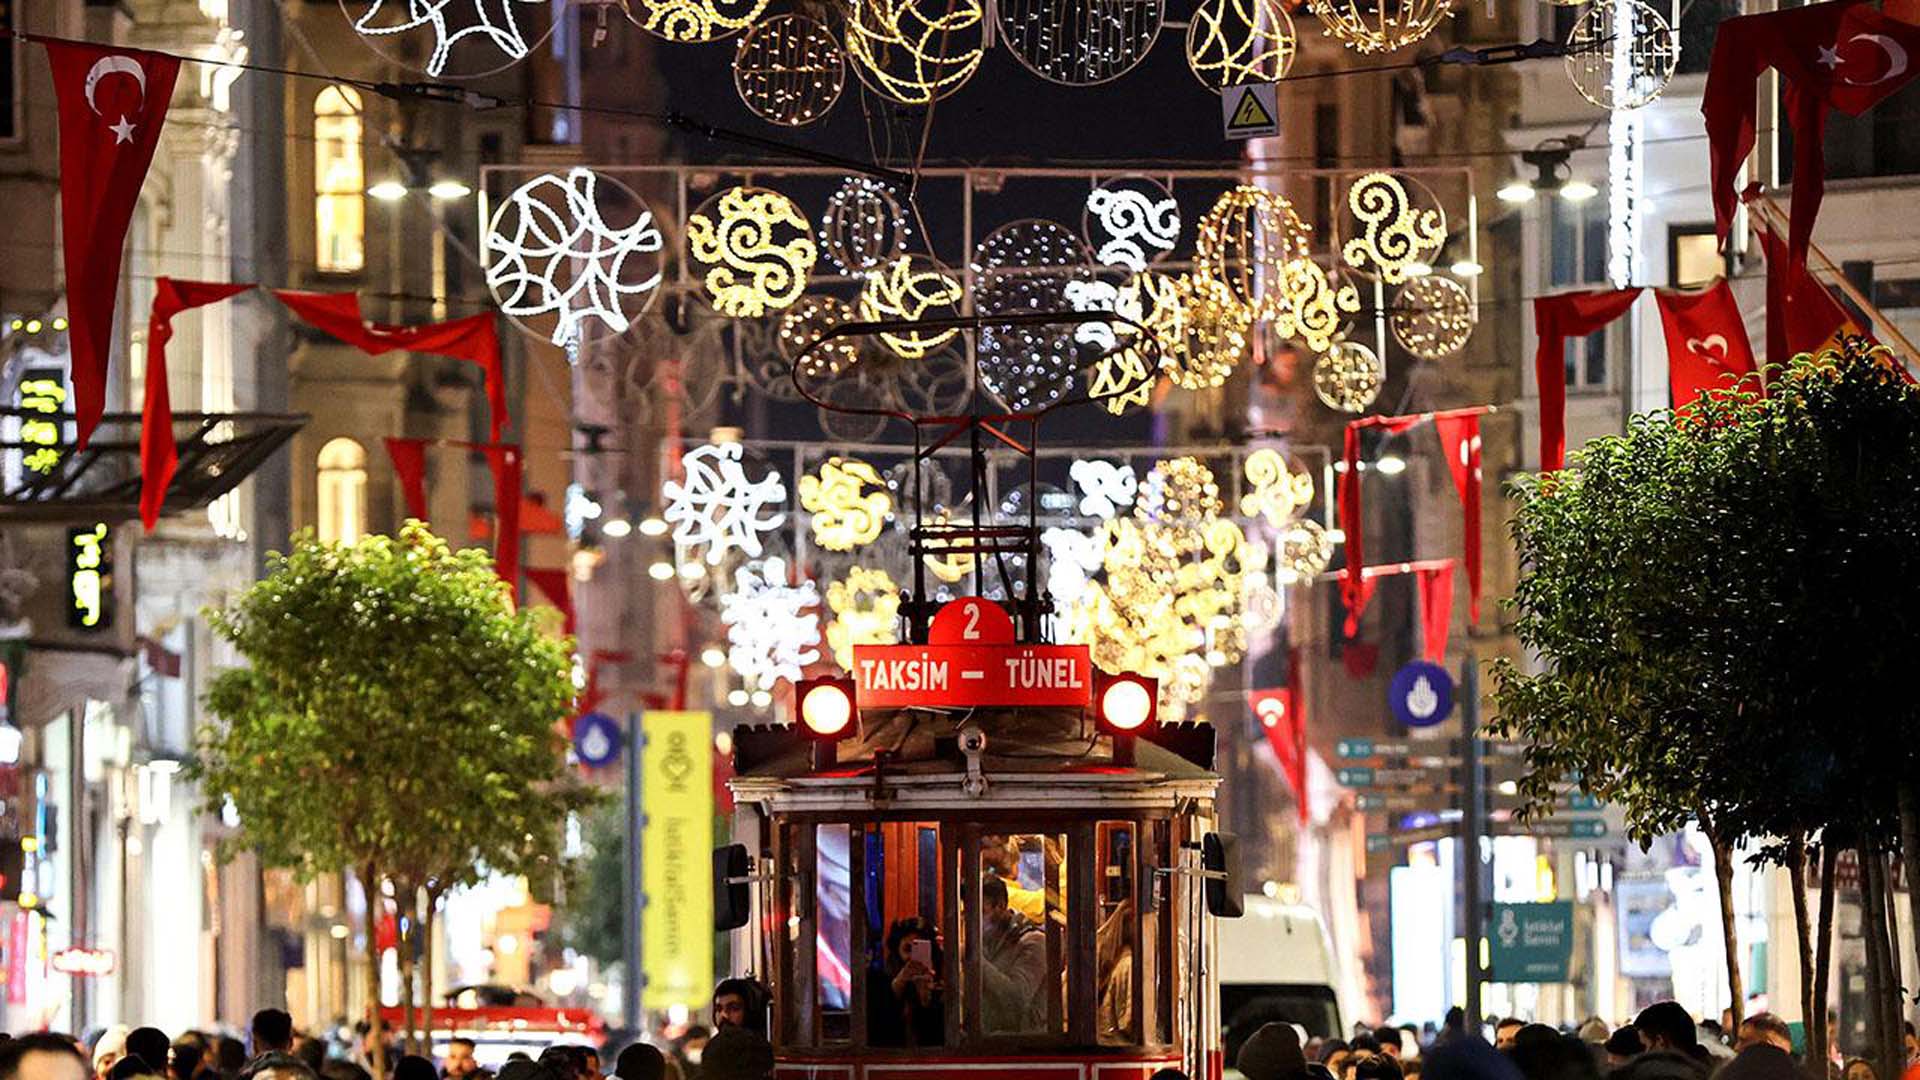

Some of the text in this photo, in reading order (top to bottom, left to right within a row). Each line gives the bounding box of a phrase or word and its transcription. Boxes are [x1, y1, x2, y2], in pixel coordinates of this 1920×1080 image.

[963, 602, 980, 640] 2
[860, 652, 948, 691] TAKSİM
[1005, 651, 1082, 689] TÜNEL
